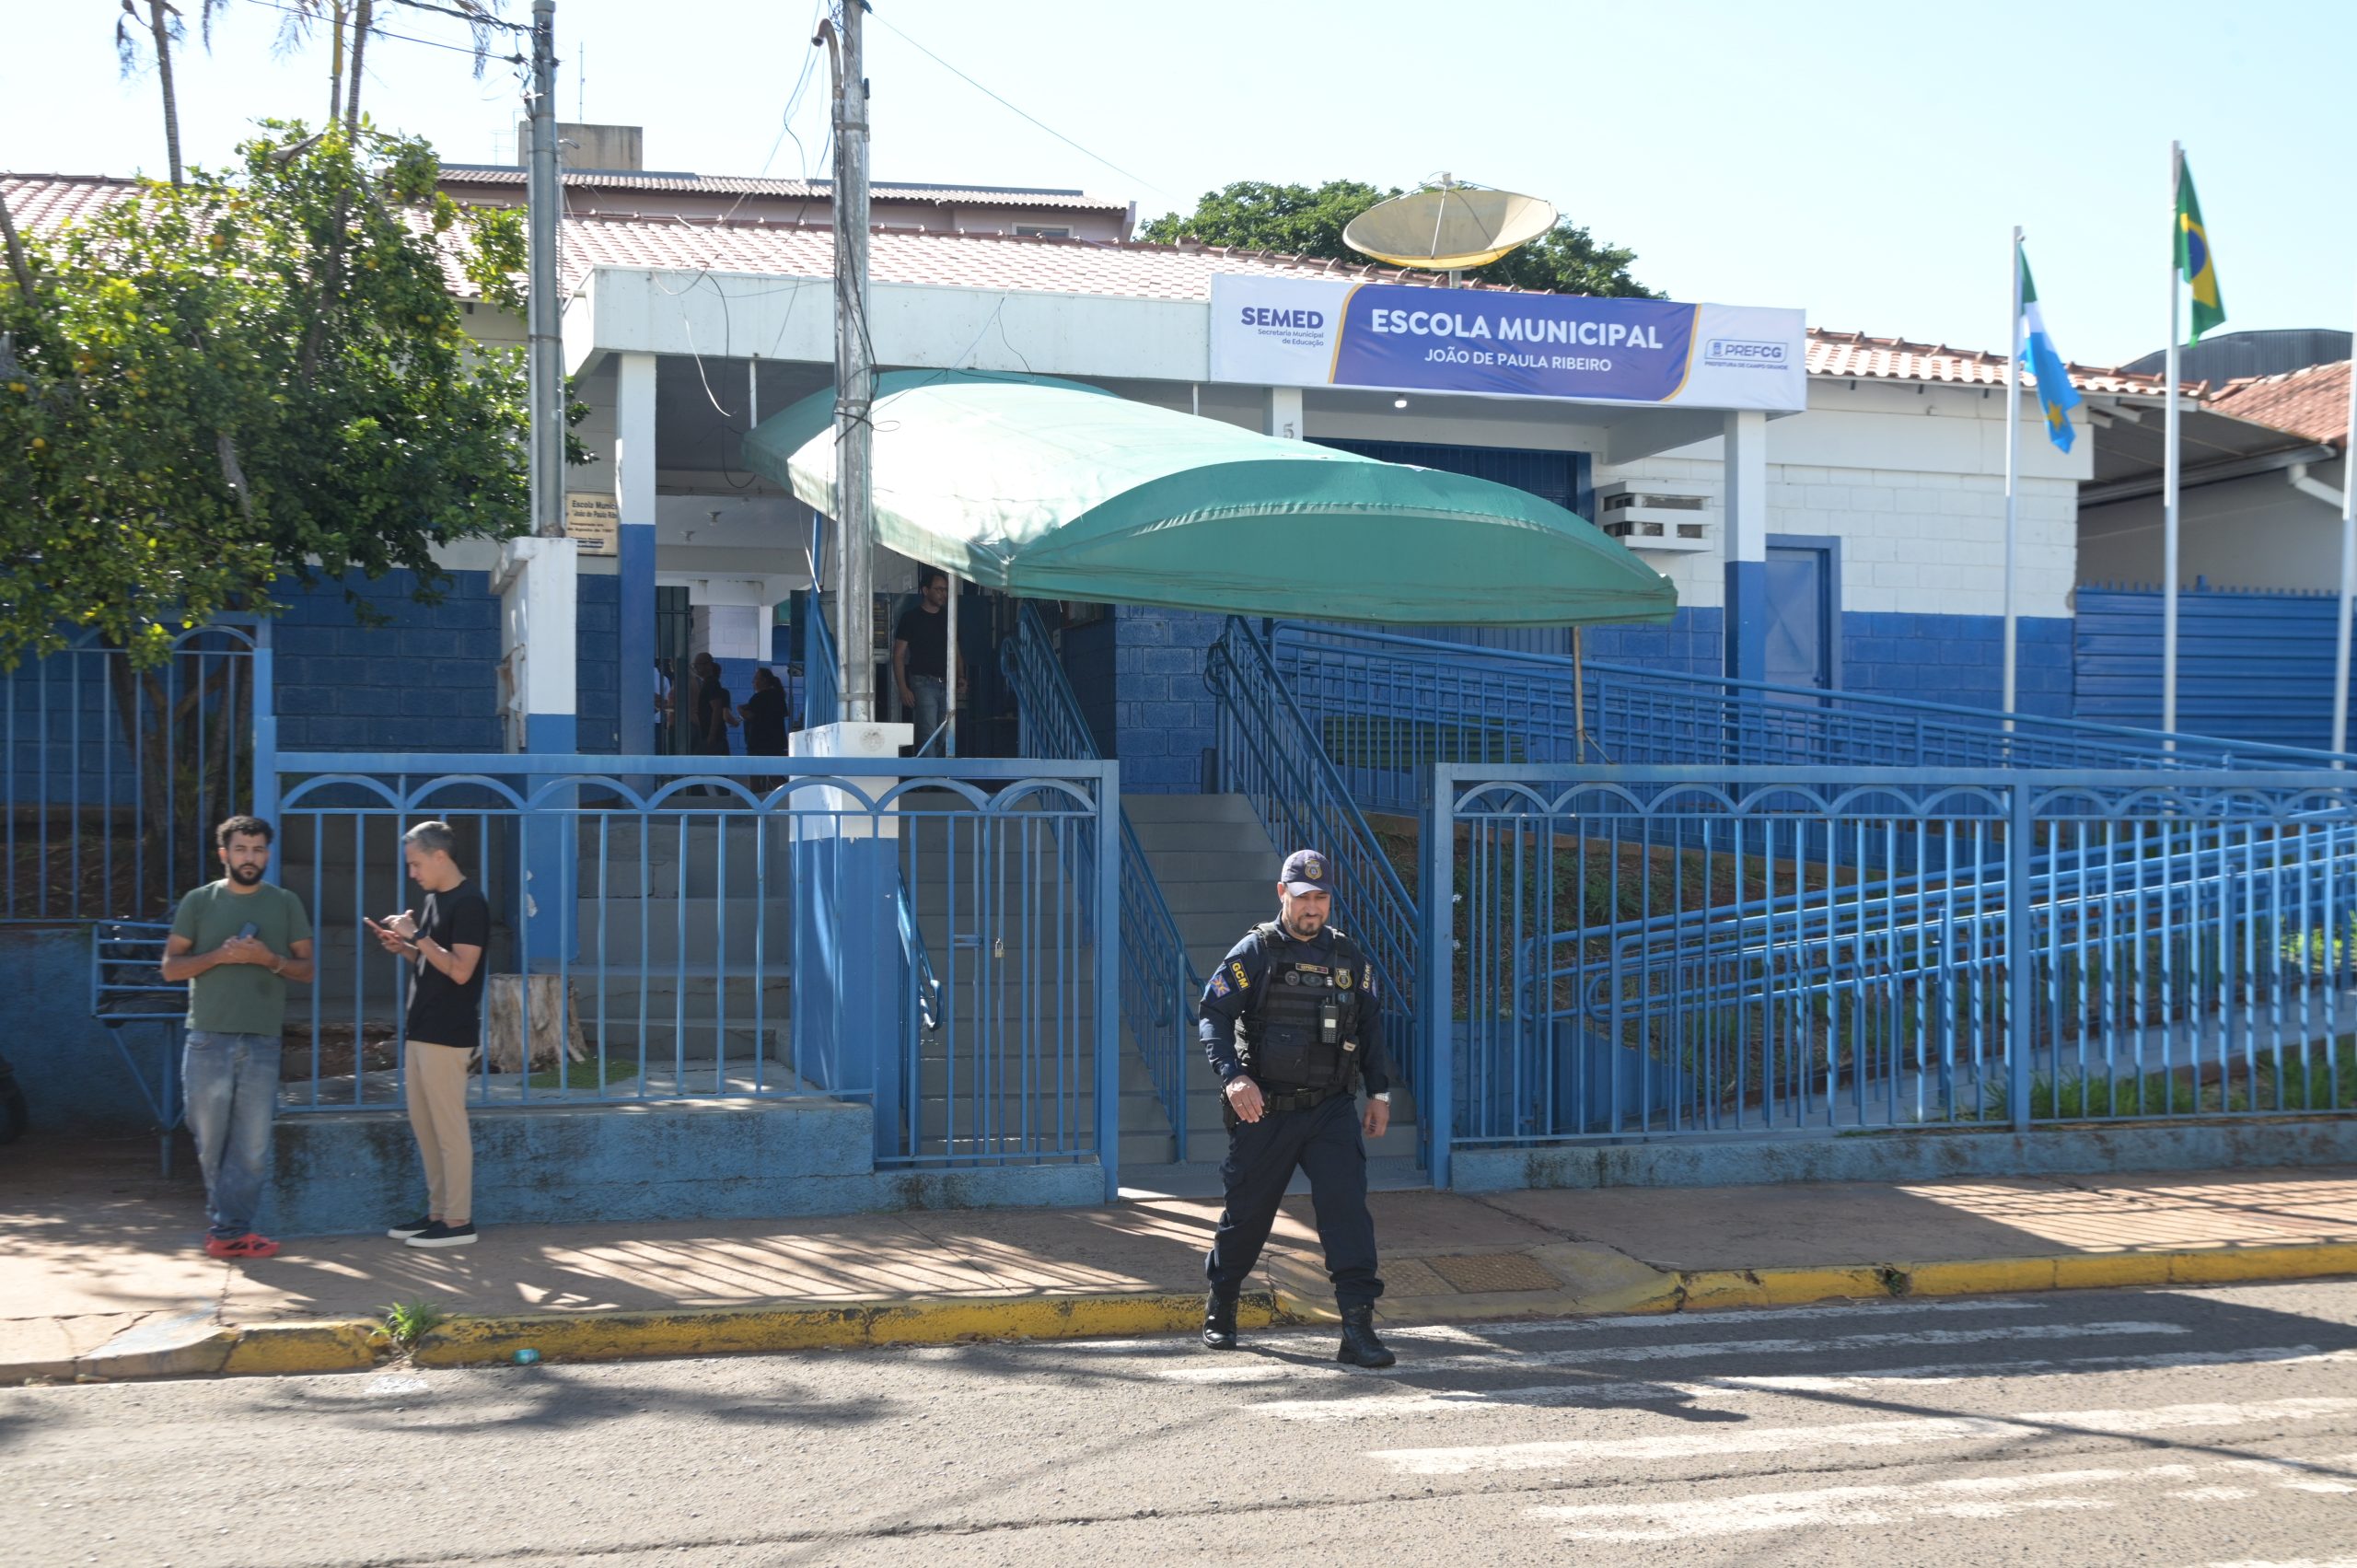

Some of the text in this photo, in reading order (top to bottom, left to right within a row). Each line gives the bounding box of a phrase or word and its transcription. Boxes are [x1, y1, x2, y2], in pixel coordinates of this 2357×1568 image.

[1240, 307, 1324, 330] SEMED
[1258, 329, 1324, 339] Secretaria Municipal
[1371, 308, 1664, 349] ESCOLA MUNICIPAL
[1292, 339, 1324, 348] Educação
[1724, 344, 1782, 358] PREFCG
[1424, 346, 1612, 372] JOÃO DE PAULA RIBEIRO
[1283, 421, 1294, 439] 5
[572, 500, 594, 508] Escola
[1232, 962, 1248, 989] GCM
